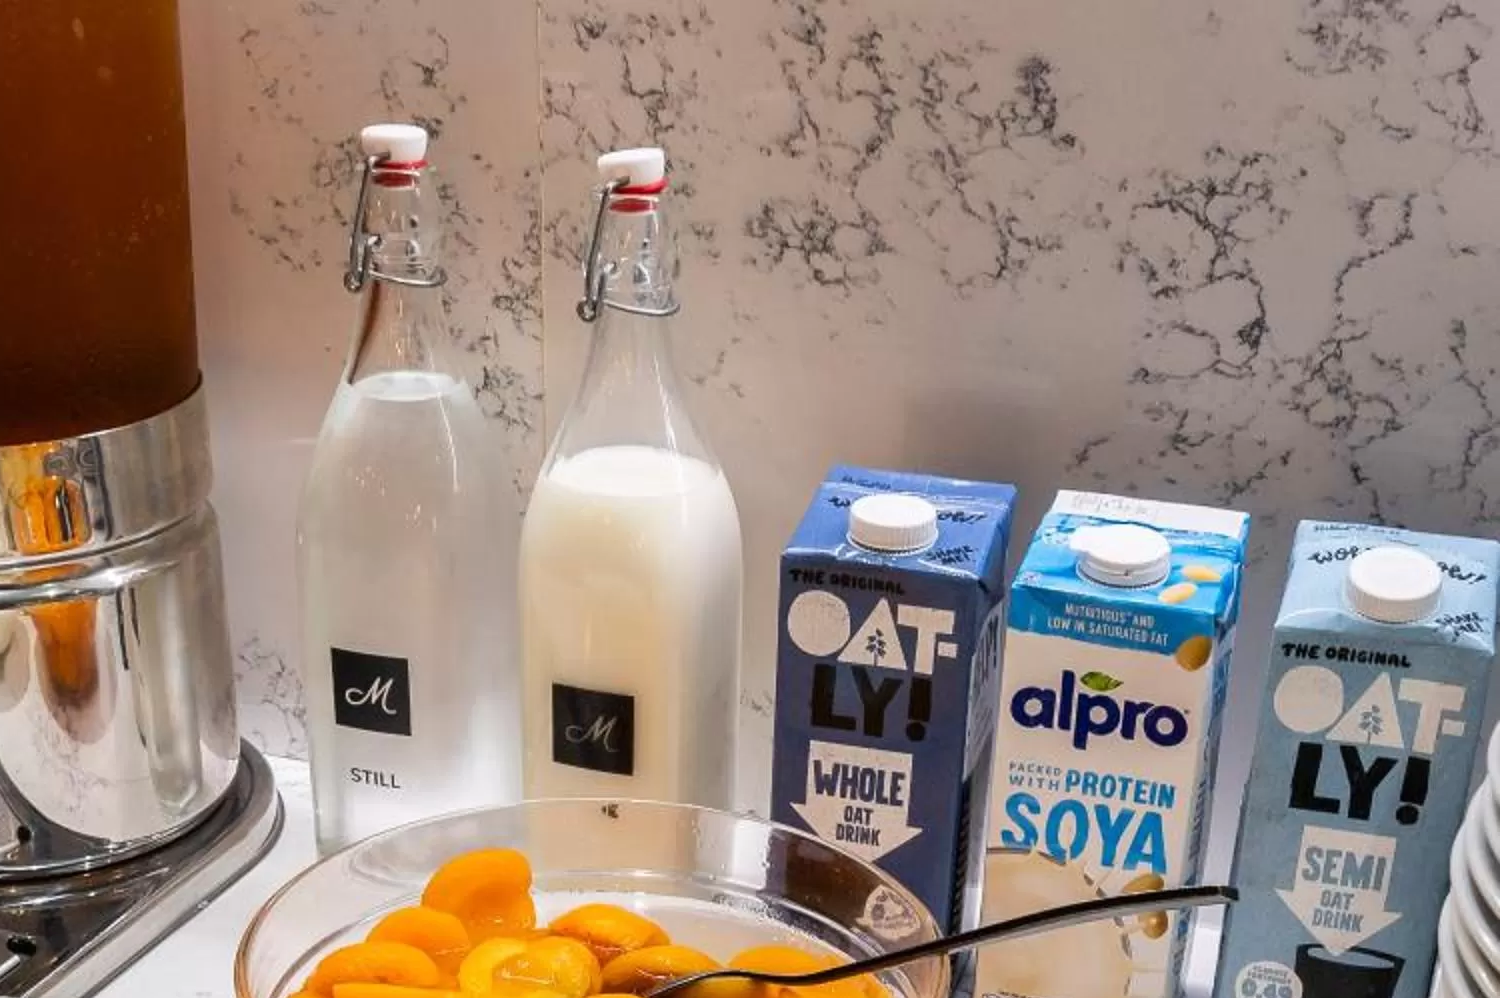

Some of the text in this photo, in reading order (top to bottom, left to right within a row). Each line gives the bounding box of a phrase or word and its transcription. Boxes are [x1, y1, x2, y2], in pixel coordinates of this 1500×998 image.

[789, 568, 906, 595] THE ORIGINAL
[1047, 615, 1169, 647] LOW IN SATURATED FAT
[1281, 642, 1412, 668] THE ORIGINAL
[810, 663, 933, 742] LY!
[1010, 669, 1188, 750] alpro
[349, 766, 401, 791] STILL
[812, 758, 907, 807] WHOLE
[1008, 760, 1062, 777] PACKED
[1008, 768, 1176, 809] WITH PROTEIN
[1288, 741, 1432, 826] LY!
[843, 804, 874, 826] OAT
[835, 822, 881, 848] DRINK
[1001, 791, 1168, 875] SOYA
[1301, 845, 1388, 891] SEMI
[1319, 888, 1355, 911] OAT
[1311, 909, 1365, 933] DRINK
